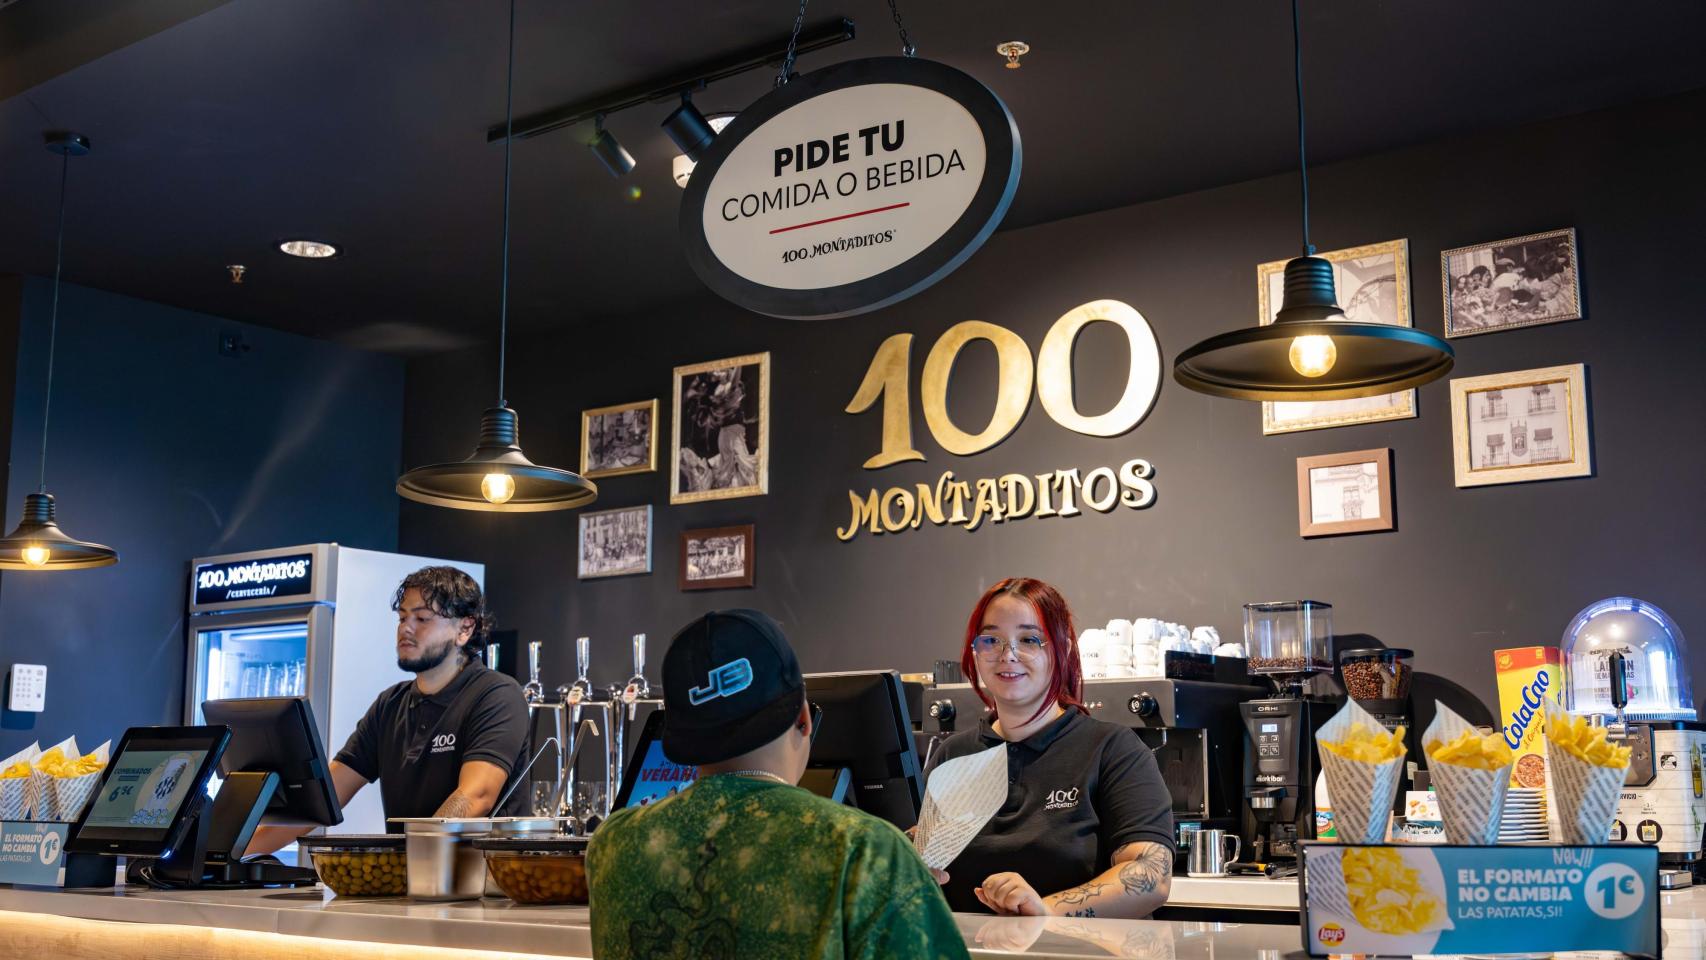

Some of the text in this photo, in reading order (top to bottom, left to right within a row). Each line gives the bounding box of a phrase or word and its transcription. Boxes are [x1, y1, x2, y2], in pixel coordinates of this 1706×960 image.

[774, 120, 905, 177] PIDE TU
[721, 149, 965, 222] COMIDA O BEBIDA
[782, 231, 894, 264] 100 MONTADITOS
[844, 299, 1160, 469] 100
[836, 459, 1156, 541] MONTADITOS
[199, 560, 306, 589] 100 MONTADITOS
[432, 733, 456, 747] 100
[1046, 787, 1079, 804] 100
[1458, 868, 1583, 884] EL FORMATO
[1458, 887, 1572, 902] NO CAMBIA
[1597, 875, 1635, 909] 1€
[1458, 907, 1483, 919] LAS
